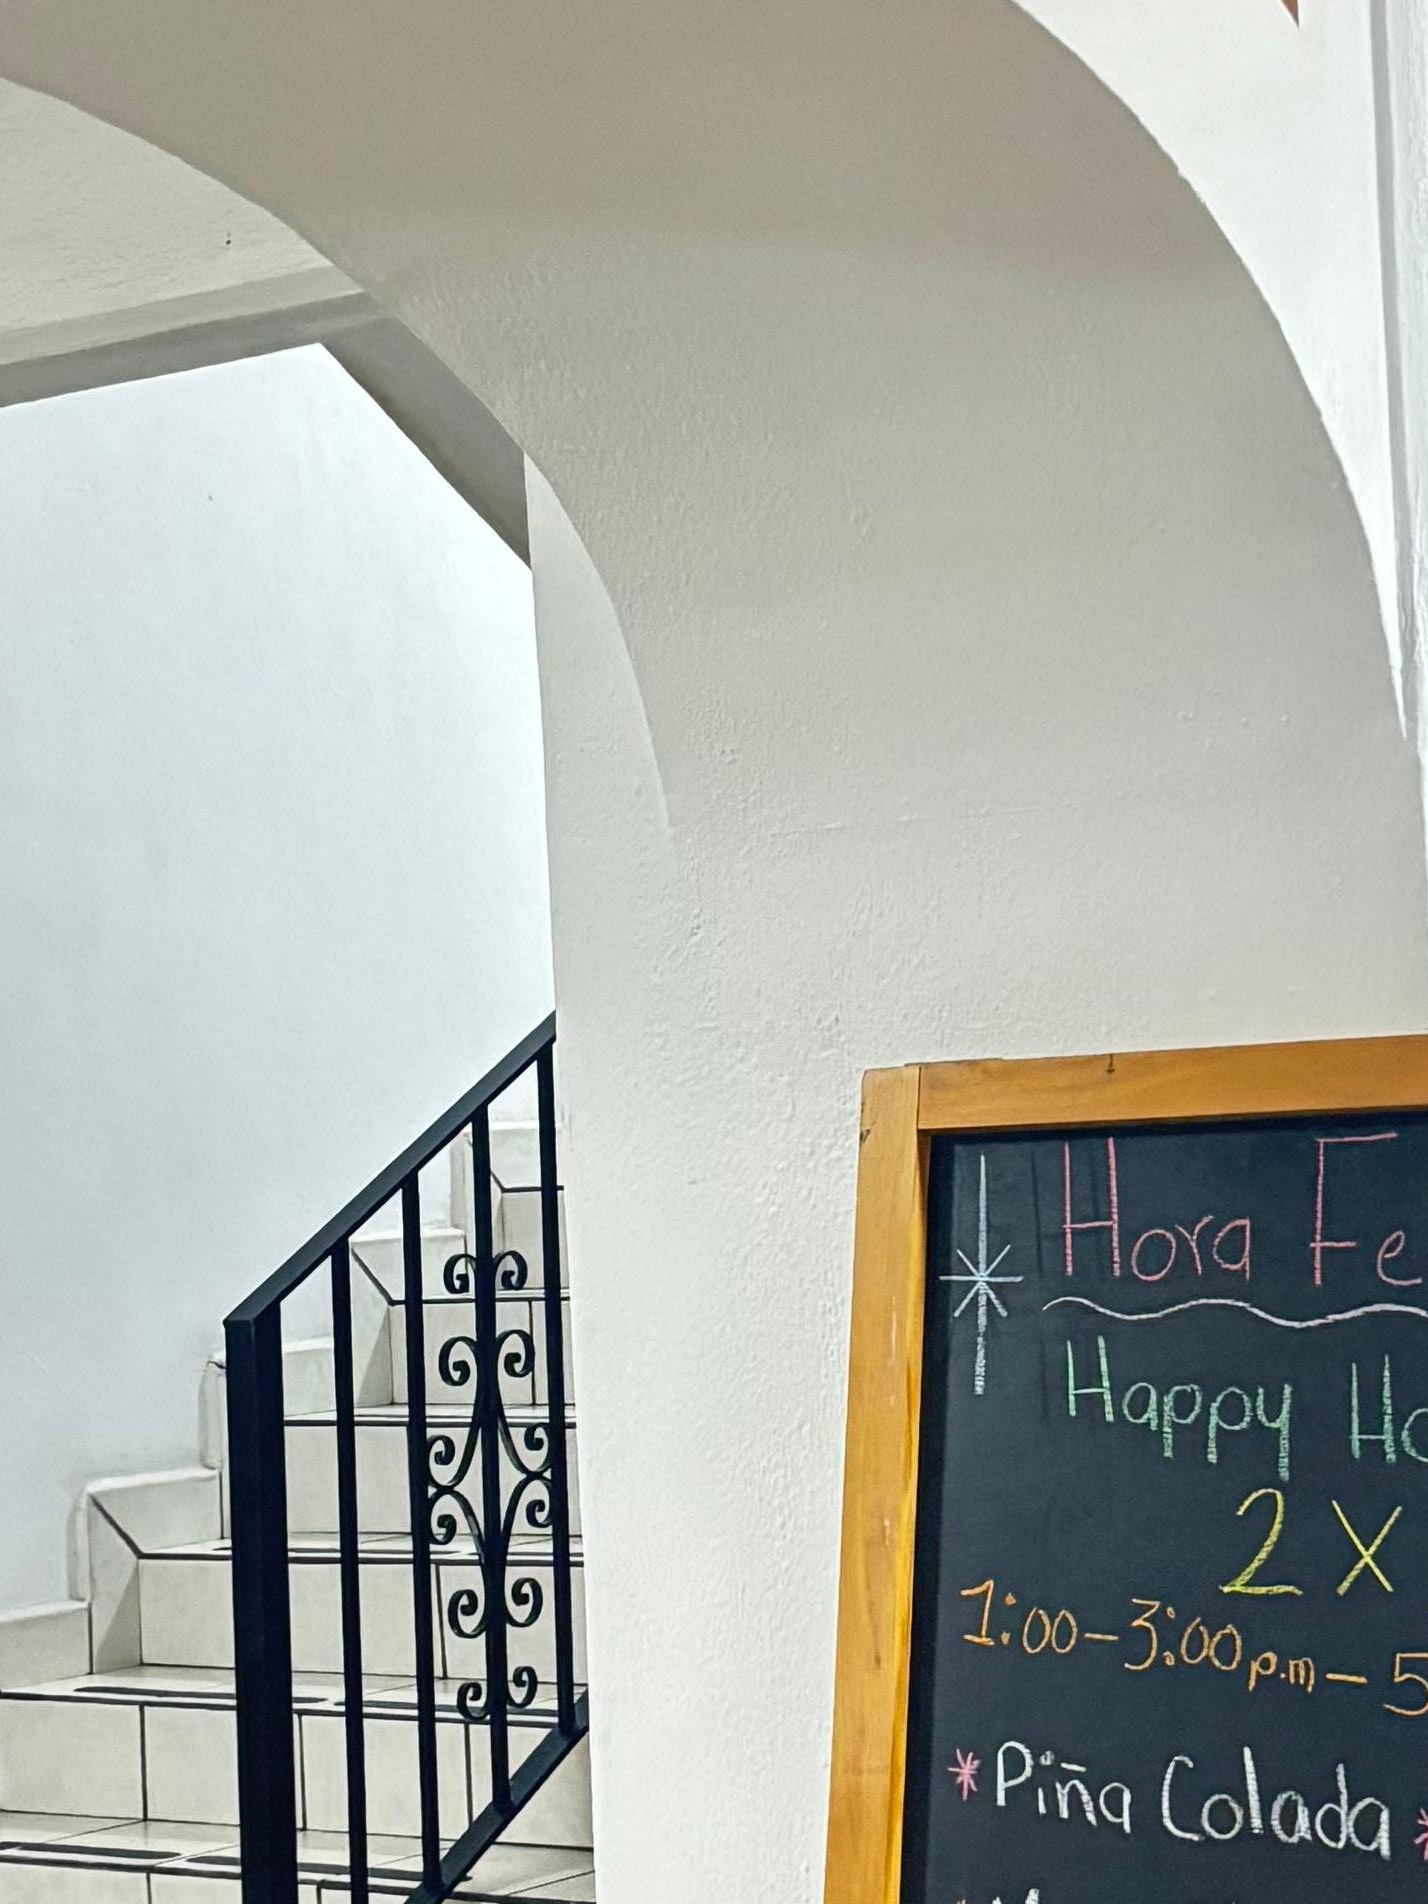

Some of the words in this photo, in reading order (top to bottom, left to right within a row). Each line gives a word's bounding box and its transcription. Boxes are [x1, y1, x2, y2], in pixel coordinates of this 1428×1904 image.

[1063, 1135, 1253, 1285] Hora
[1065, 1335, 1294, 1482] Happy
[1219, 1487, 1304, 1595] 2
[995, 1740, 1132, 1835] Piña
[1162, 1745, 1393, 1862] Colada
